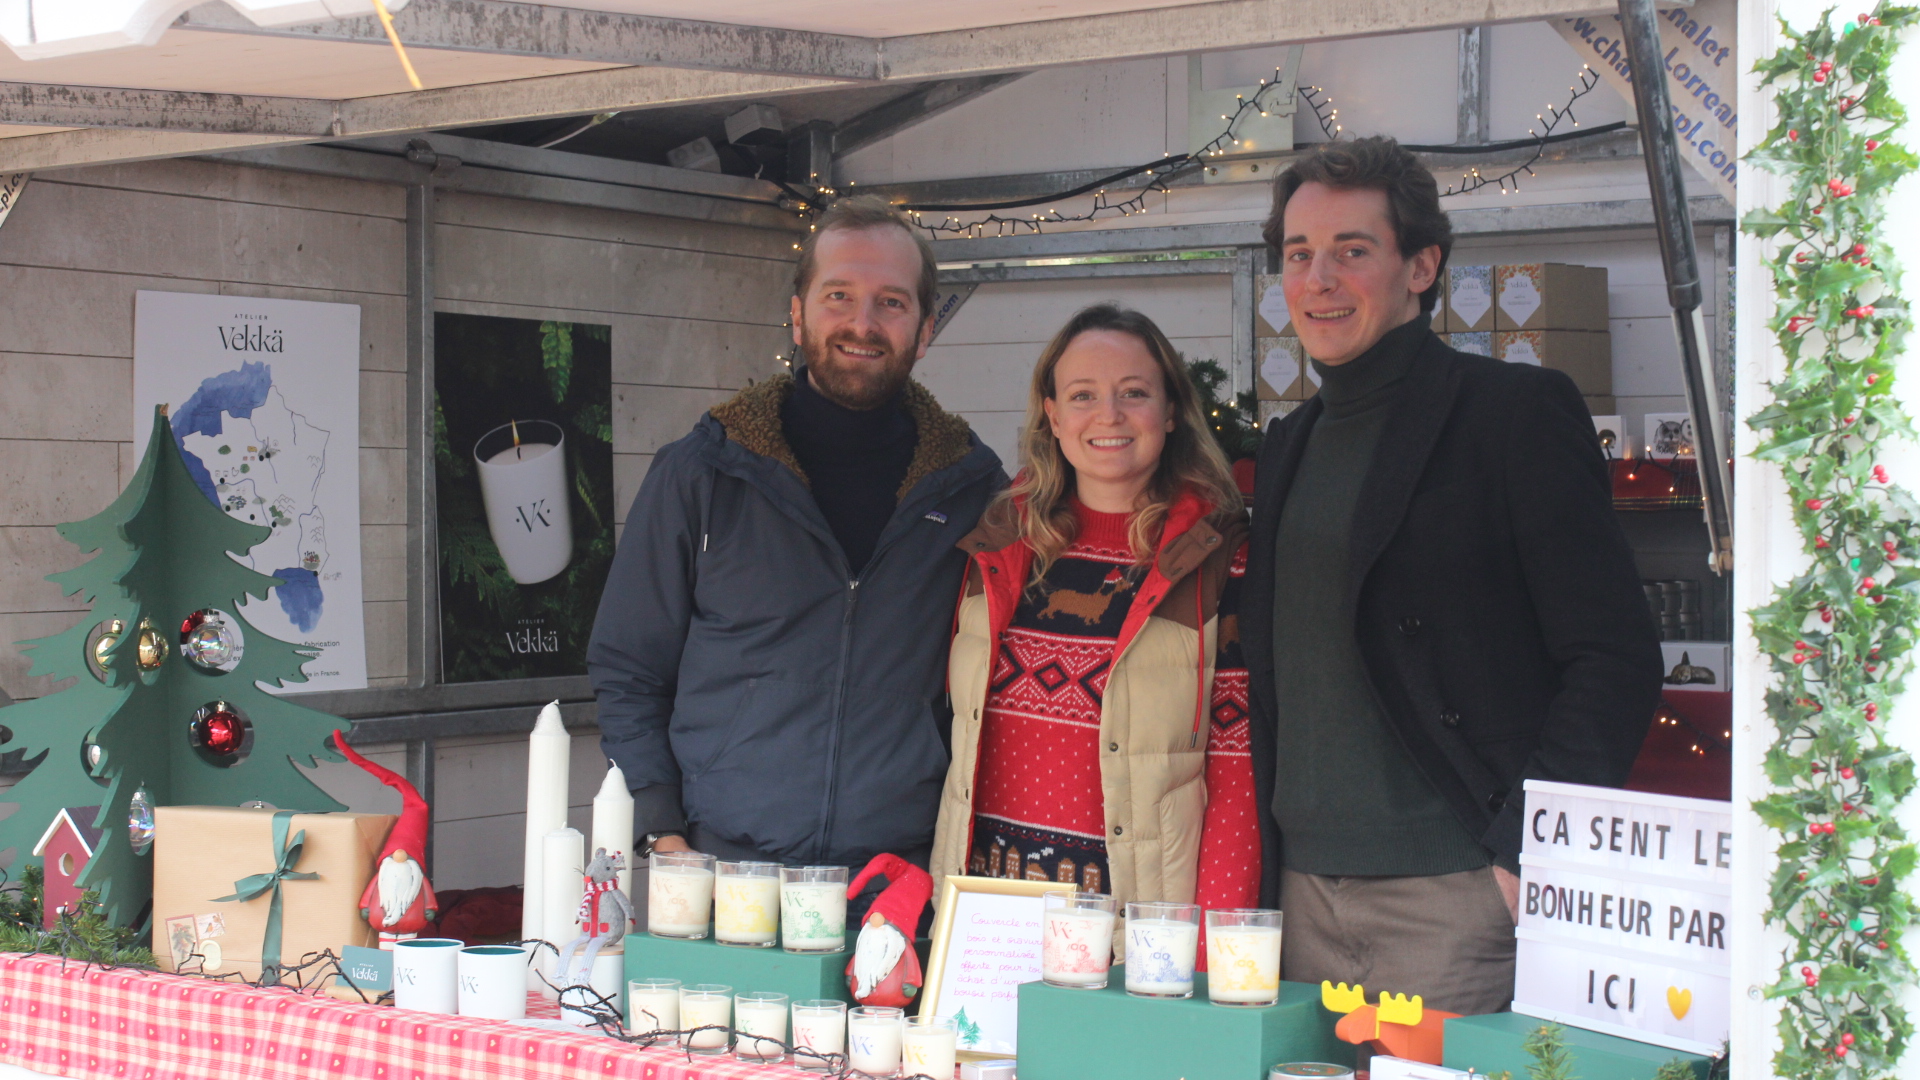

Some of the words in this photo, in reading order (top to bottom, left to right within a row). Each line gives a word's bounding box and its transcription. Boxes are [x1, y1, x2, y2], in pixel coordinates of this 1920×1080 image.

[217, 324, 284, 353] Vekkä
[506, 628, 558, 653] Vekkä
[1532, 808, 1570, 846] CA
[1589, 816, 1671, 860] SENT
[1694, 829, 1732, 869] LE
[971, 912, 1021, 928] Couvercle
[1525, 881, 1652, 937] BONHEUR
[1668, 905, 1725, 950] PAR
[966, 931, 987, 942] bois
[963, 948, 1038, 959] personnalisée
[998, 964, 1024, 974] pour
[1588, 969, 1636, 1013] ICI
